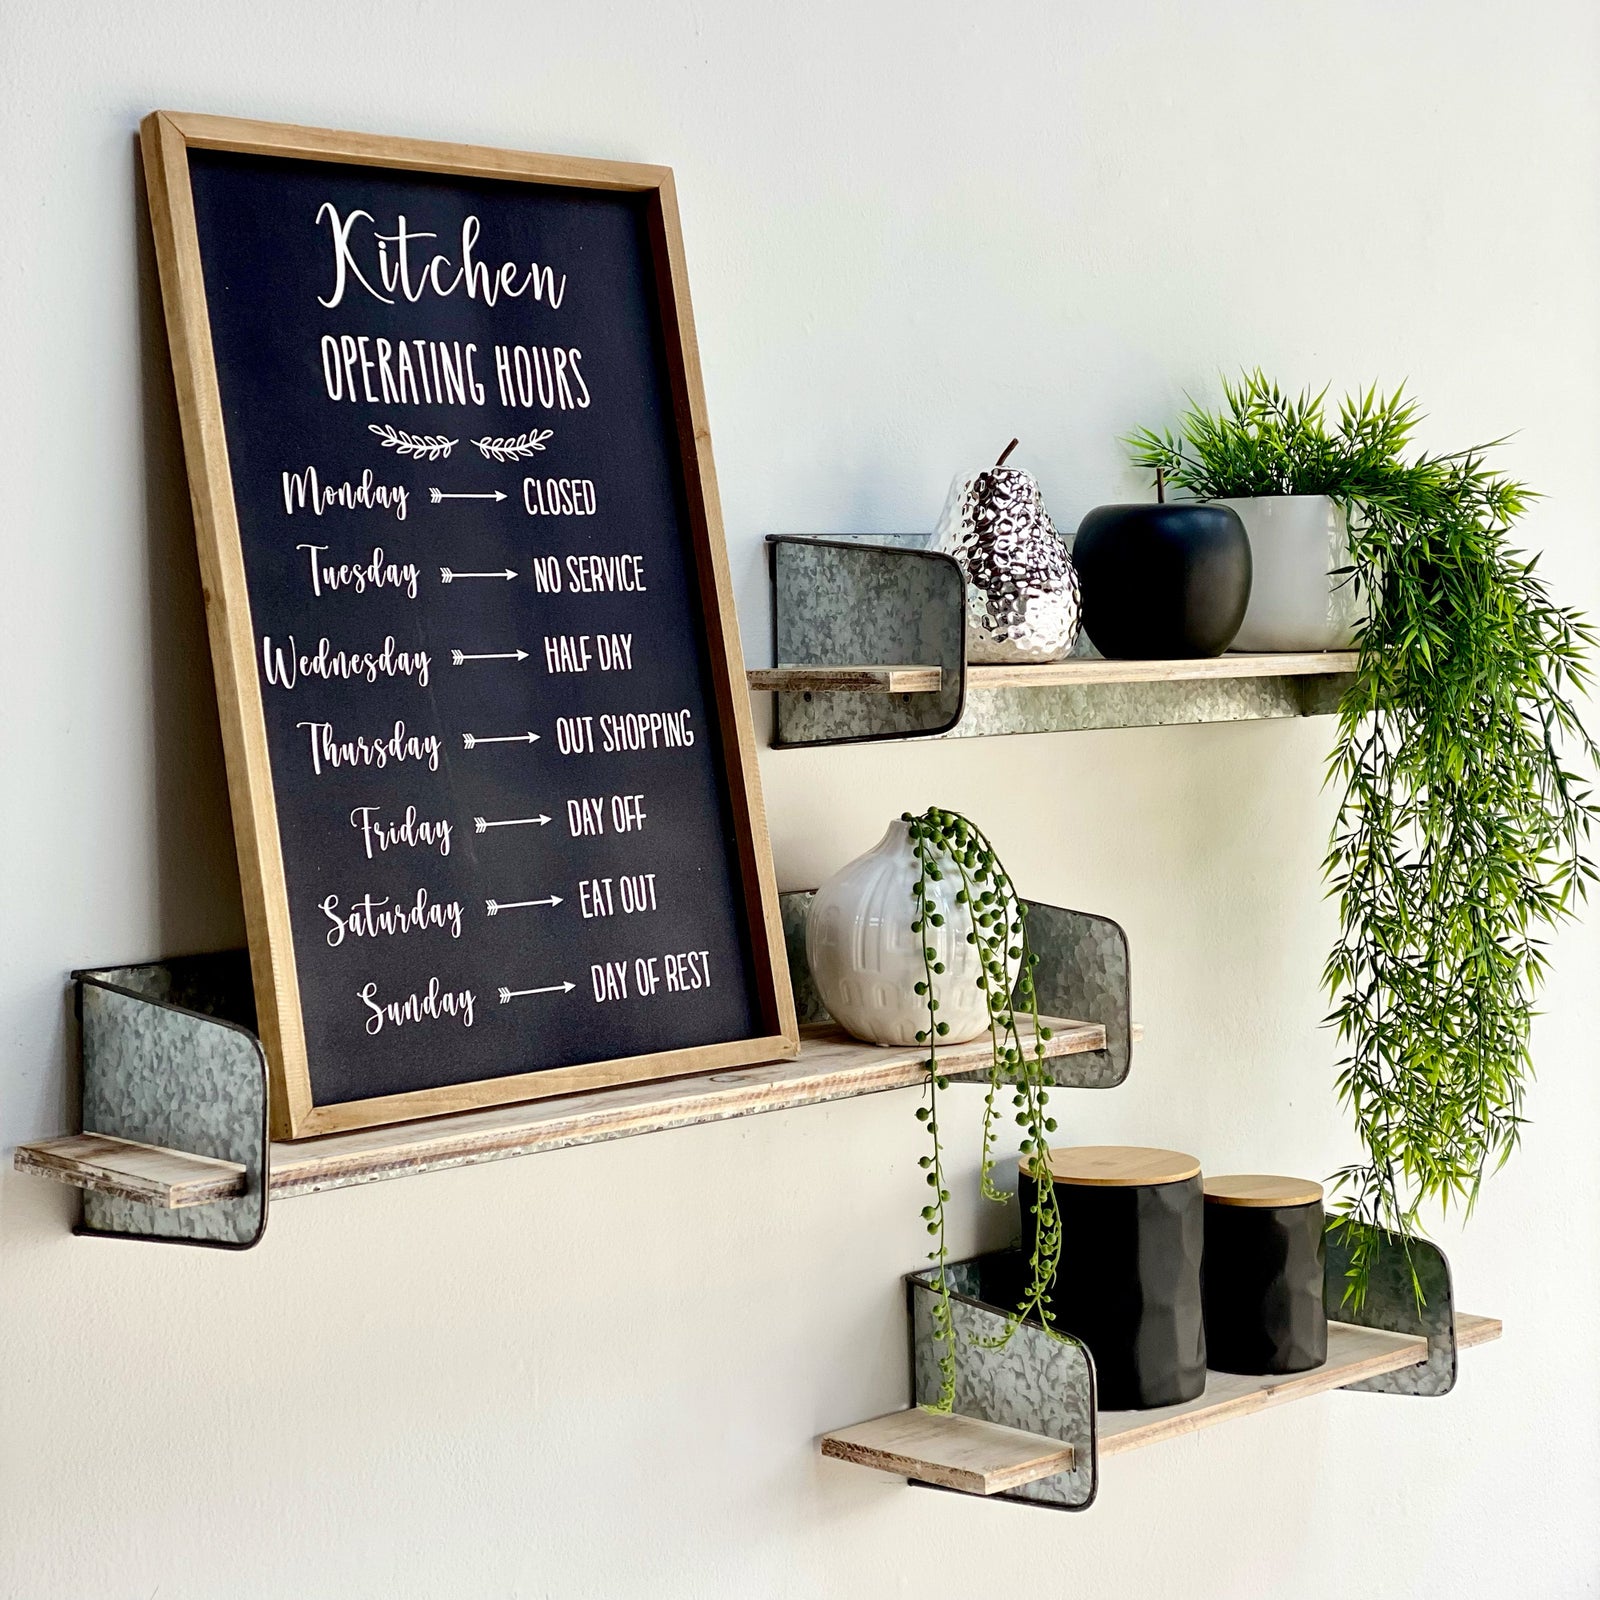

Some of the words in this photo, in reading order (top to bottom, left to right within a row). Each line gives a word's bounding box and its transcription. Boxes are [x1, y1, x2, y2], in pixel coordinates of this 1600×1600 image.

[316, 203, 567, 310] Kitchen
[322, 335, 486, 406] OPERATING
[495, 346, 591, 411] HOURS
[283, 466, 410, 521] Monday
[523, 477, 597, 516] CLOSED
[296, 544, 421, 599] Tuesday
[534, 557, 562, 594] NO
[566, 555, 647, 593] SERVICE
[264, 635, 432, 690] Wednesday
[545, 636, 593, 674] HALF
[597, 634, 633, 671] DAY
[297, 720, 442, 775] Thursday
[557, 716, 594, 755] OUT
[600, 709, 695, 753] SHOPPING
[350, 806, 453, 859] Friday
[567, 797, 608, 837] DAY
[612, 795, 647, 834] OFF
[318, 888, 464, 947] Saturday
[579, 879, 615, 919] EAT
[619, 874, 657, 914] OUT
[357, 977, 477, 1035] Sunday
[591, 960, 628, 1003] DAY
[635, 957, 662, 997] OF
[665, 950, 711, 993] REST
